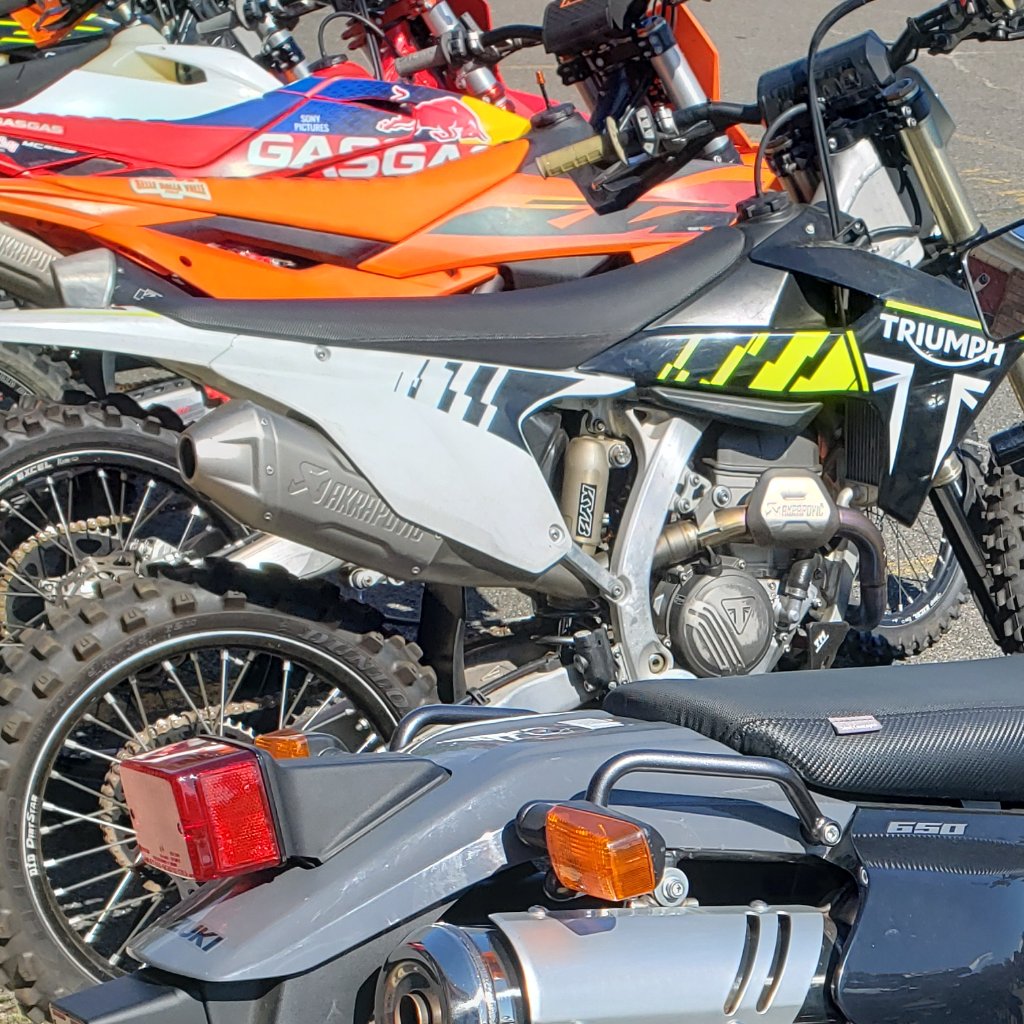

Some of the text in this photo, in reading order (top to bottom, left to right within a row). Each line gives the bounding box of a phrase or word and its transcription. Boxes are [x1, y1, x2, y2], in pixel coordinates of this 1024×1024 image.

[294, 122, 330, 133] PICTURES
[300, 114, 321, 123] SONY
[880, 313, 1006, 367] TRIUMPH
[577, 484, 596, 537] KYB
[299, 628, 409, 709] DUNLO
[886, 821, 969, 836] 650
